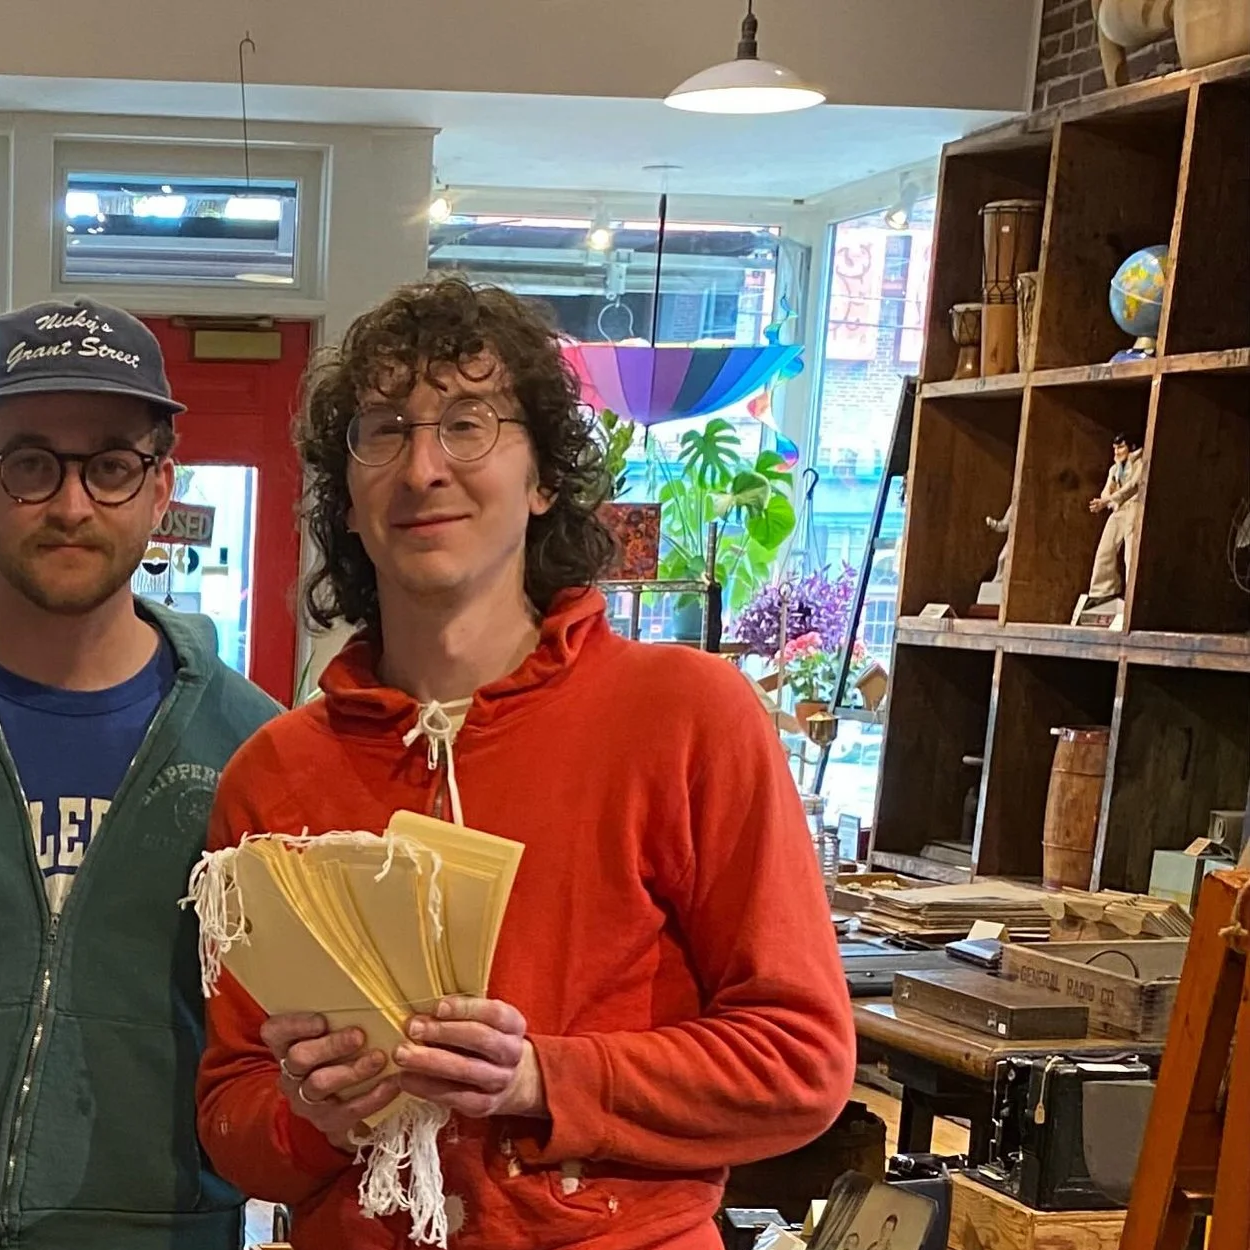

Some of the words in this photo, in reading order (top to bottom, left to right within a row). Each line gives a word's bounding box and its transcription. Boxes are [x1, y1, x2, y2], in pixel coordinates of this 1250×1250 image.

[35, 309, 114, 334] Nicky's
[6, 341, 72, 373] Grant
[77, 336, 140, 369] Street
[1019, 965, 1061, 993] GENERAL
[1066, 977, 1095, 1003] RADIO
